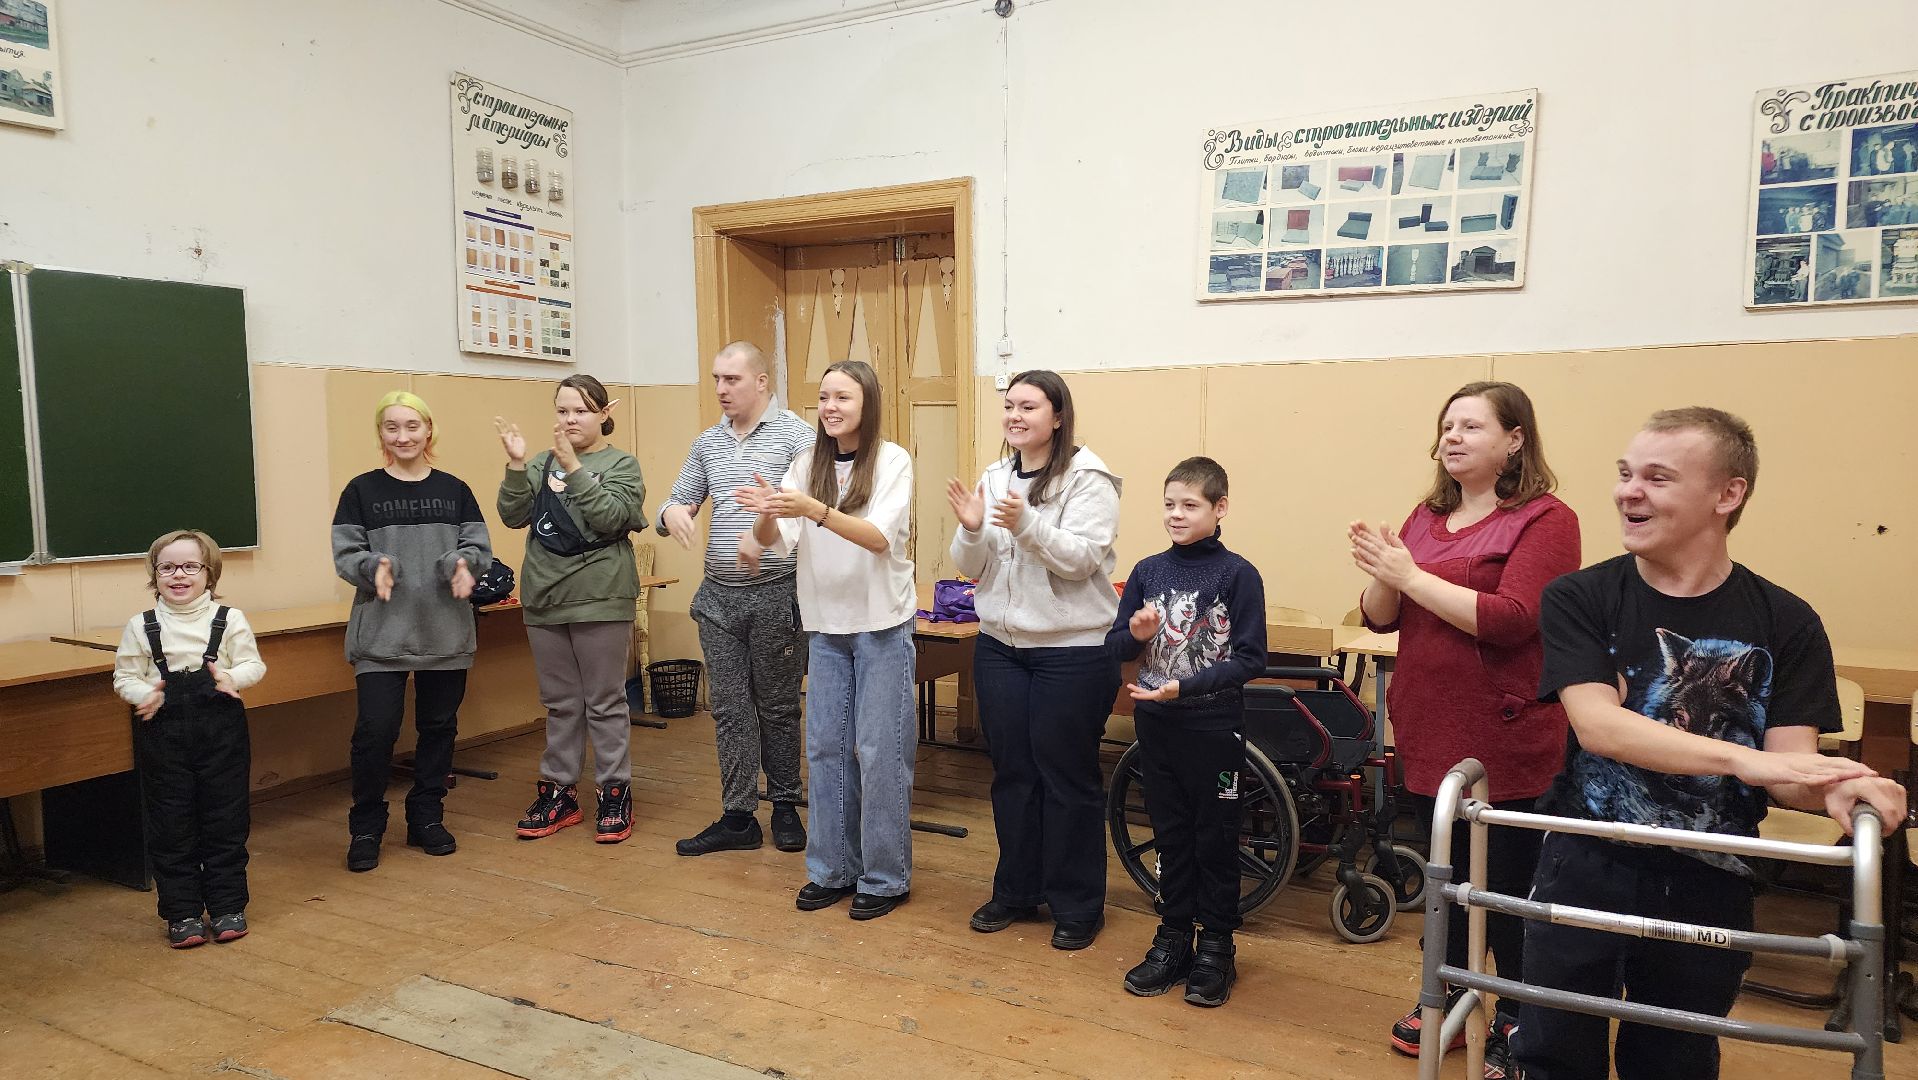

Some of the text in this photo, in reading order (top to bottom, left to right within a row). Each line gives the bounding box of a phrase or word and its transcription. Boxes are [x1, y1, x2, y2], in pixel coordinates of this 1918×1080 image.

[1225, 99, 1533, 153] Виды строительных изделий
[372, 498, 457, 519] SOMEHOW
[1697, 928, 1727, 945] MD
